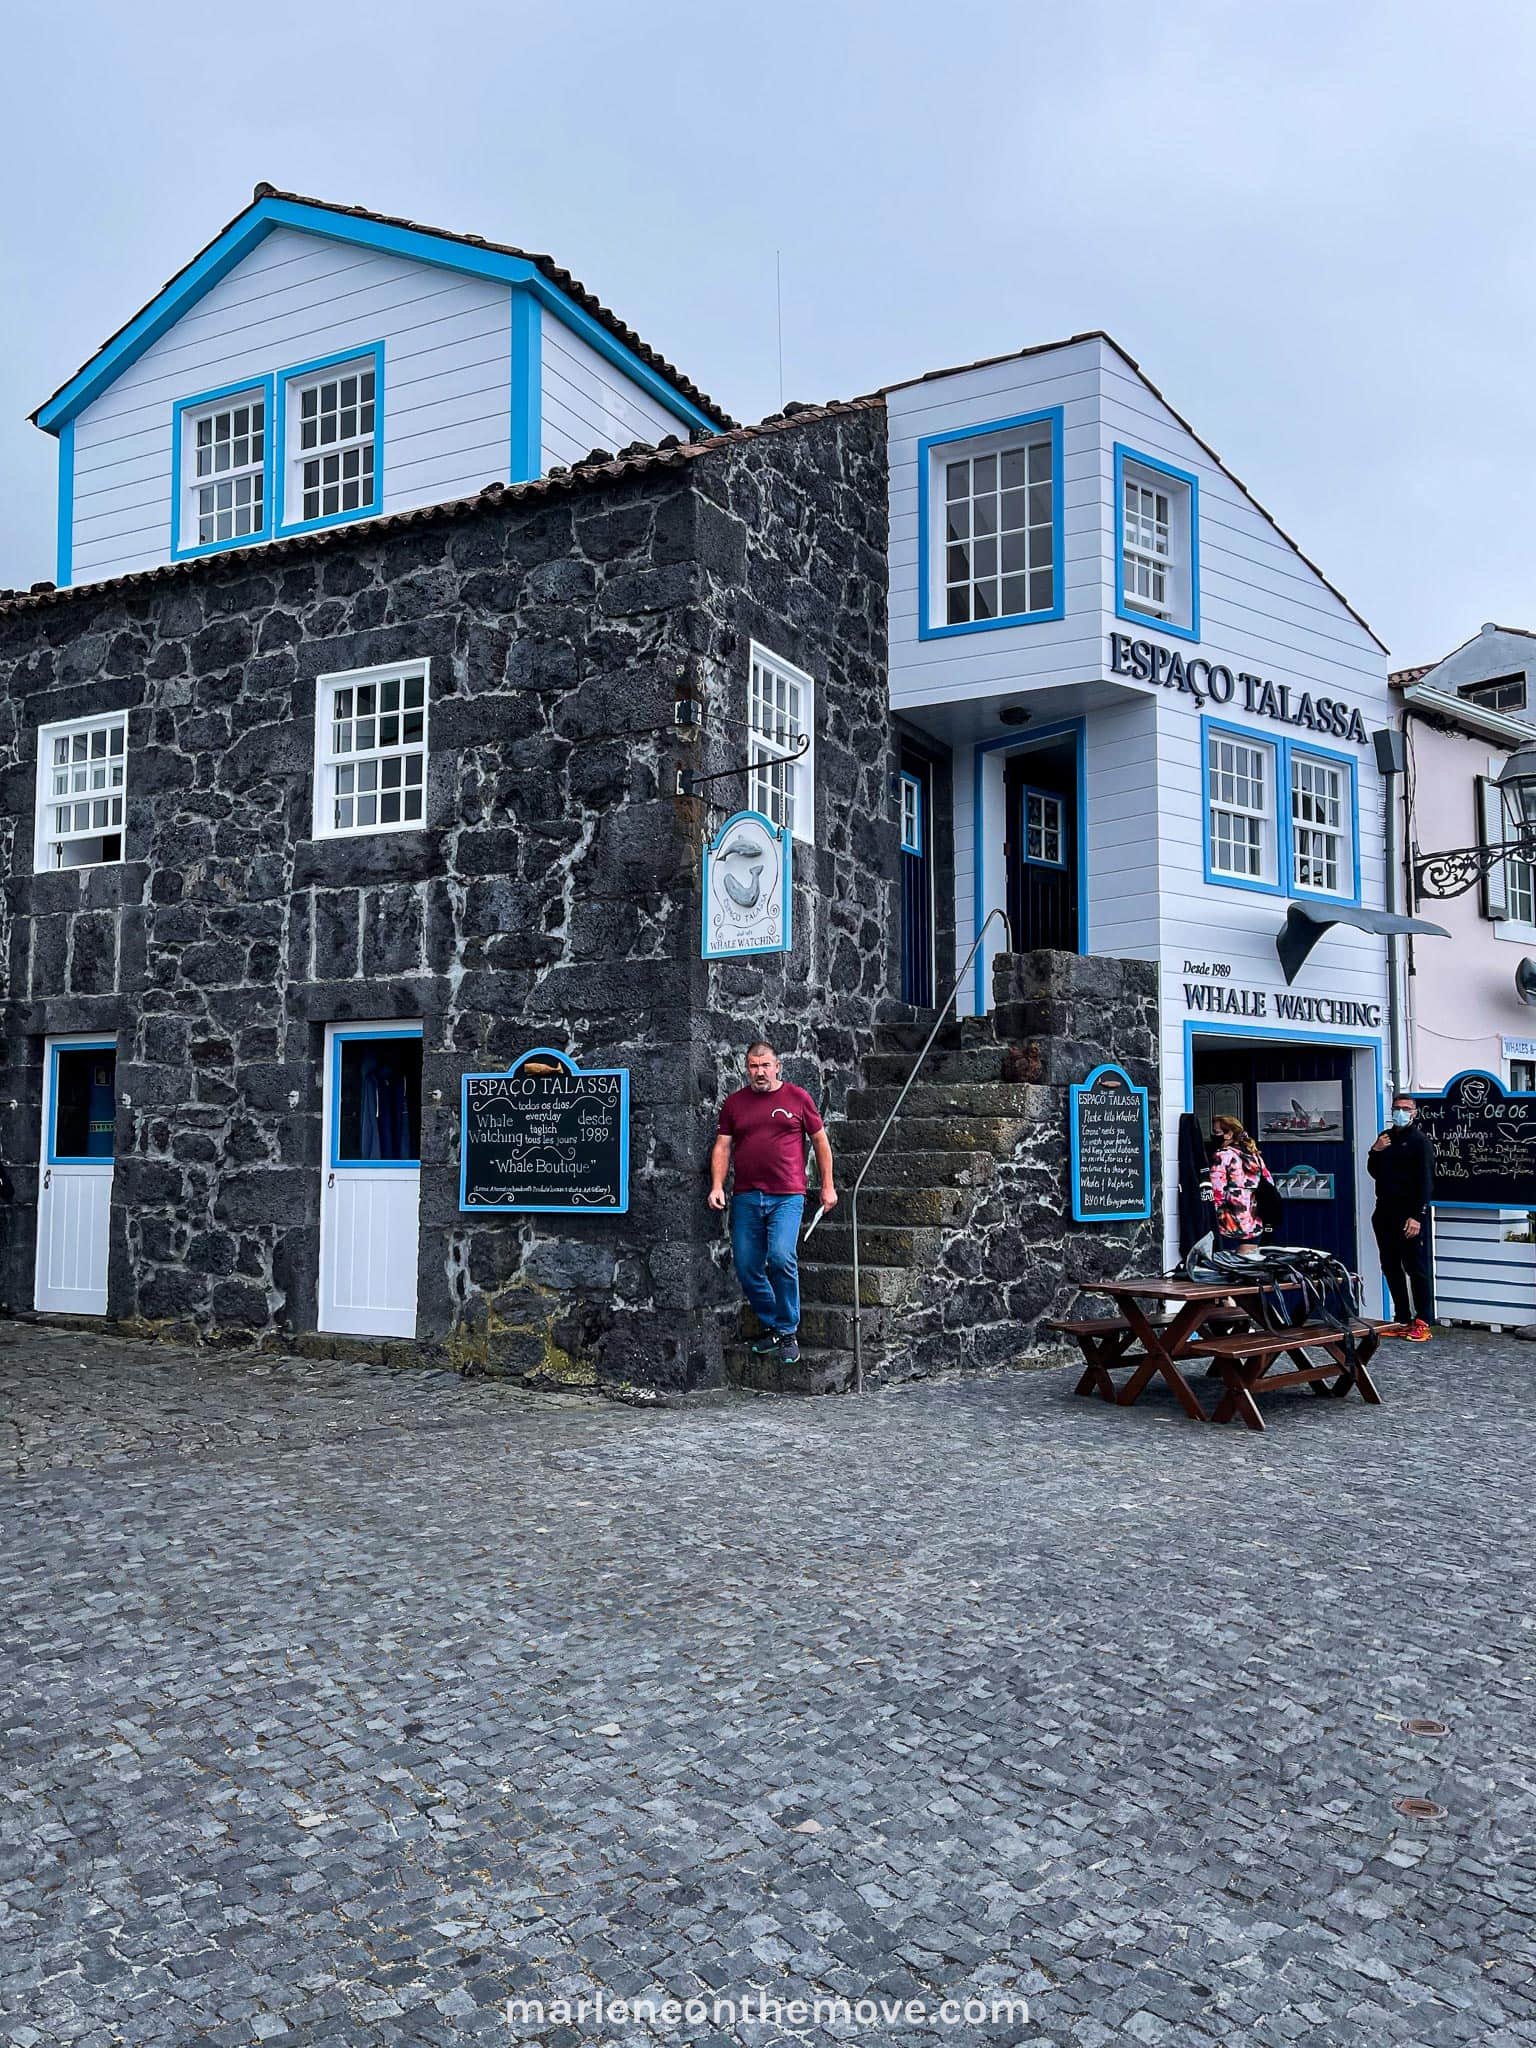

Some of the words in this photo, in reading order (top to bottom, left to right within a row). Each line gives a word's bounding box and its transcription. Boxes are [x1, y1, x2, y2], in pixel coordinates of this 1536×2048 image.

[1110, 632, 1234, 708] ESPAÇO
[1239, 672, 1368, 743] TALASSA
[710, 940, 736, 951] WHALE
[738, 935, 780, 947] WATCHING
[1183, 961, 1210, 975] Desde
[1212, 964, 1231, 977] 1989
[1183, 984, 1267, 1017] WHALE
[1274, 993, 1382, 1027] WATCHING
[468, 1078, 536, 1097] ESPAÇO
[540, 1077, 619, 1094] TALASSA
[518, 1098, 540, 1110] todos
[1079, 1093, 1106, 1106] ESPAÇO
[1109, 1095, 1140, 1106] TALASSA
[476, 1113, 514, 1128] Whale
[525, 1110, 561, 1122] everyday
[577, 1106, 613, 1125] desde
[1415, 1105, 1446, 1120] Next
[1451, 1105, 1480, 1128] Trip:
[468, 1128, 523, 1147] Watching
[524, 1134, 541, 1144] tous
[542, 1134, 554, 1144] les
[556, 1135, 578, 1147] jours
[580, 1127, 609, 1143] 1989
